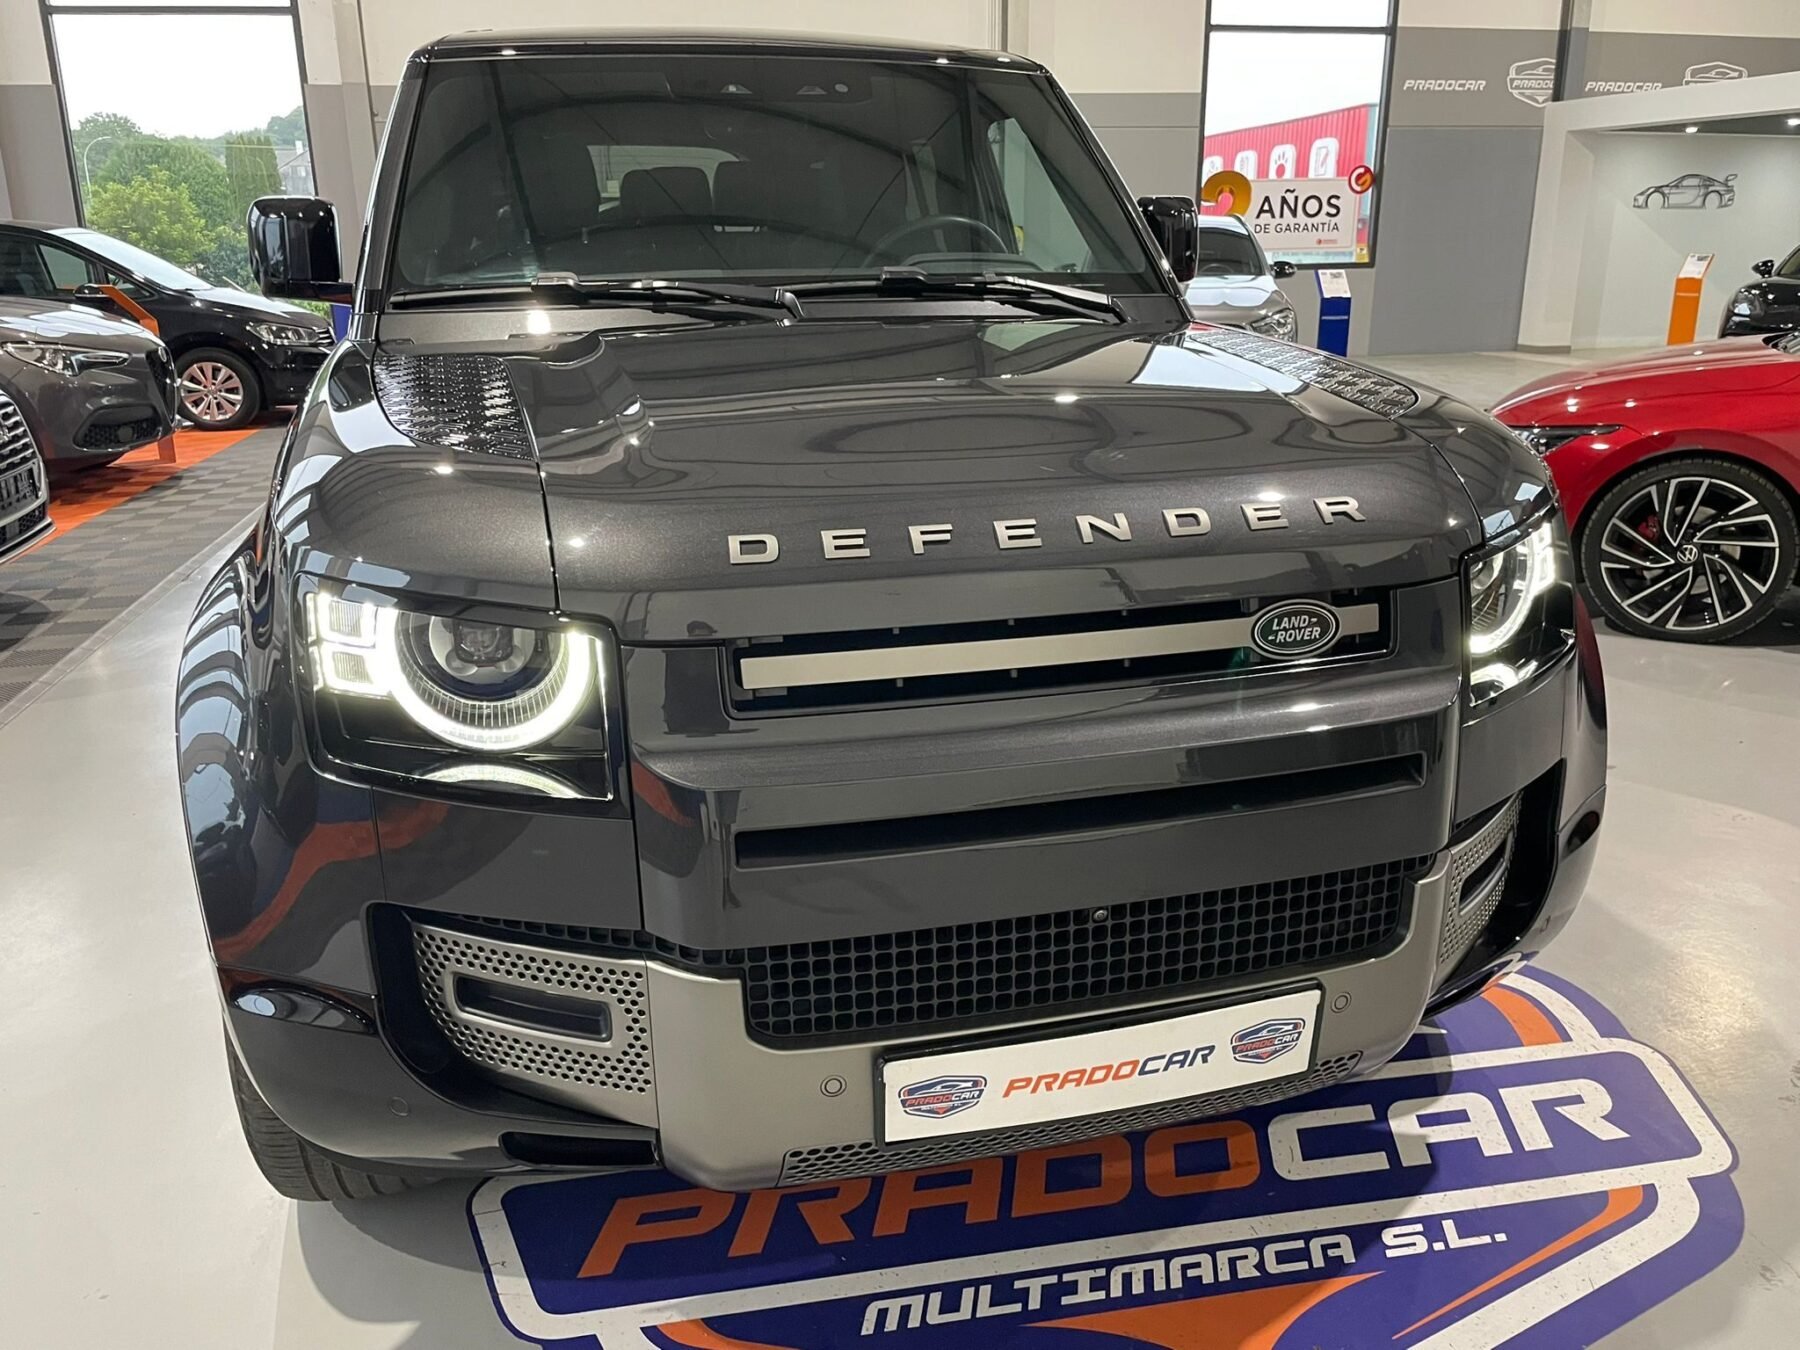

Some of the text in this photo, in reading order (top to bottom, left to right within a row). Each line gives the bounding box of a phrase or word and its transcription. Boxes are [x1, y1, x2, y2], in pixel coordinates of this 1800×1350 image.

[1403, 79, 1487, 92] PRADOCAR
[1512, 79, 1554, 89] PRADO
[1255, 188, 1341, 219] AÑOS
[1254, 220, 1340, 234] DE GARANTÍA
[728, 496, 1366, 565] DEFENDER
[1002, 1045, 1216, 1098] PRADOCAR
[905, 1091, 980, 1107] PRADOCAR
[576, 1077, 1631, 1278] PRADOCAR
[860, 1219, 1507, 1336] MULTIMARCA S.L.
